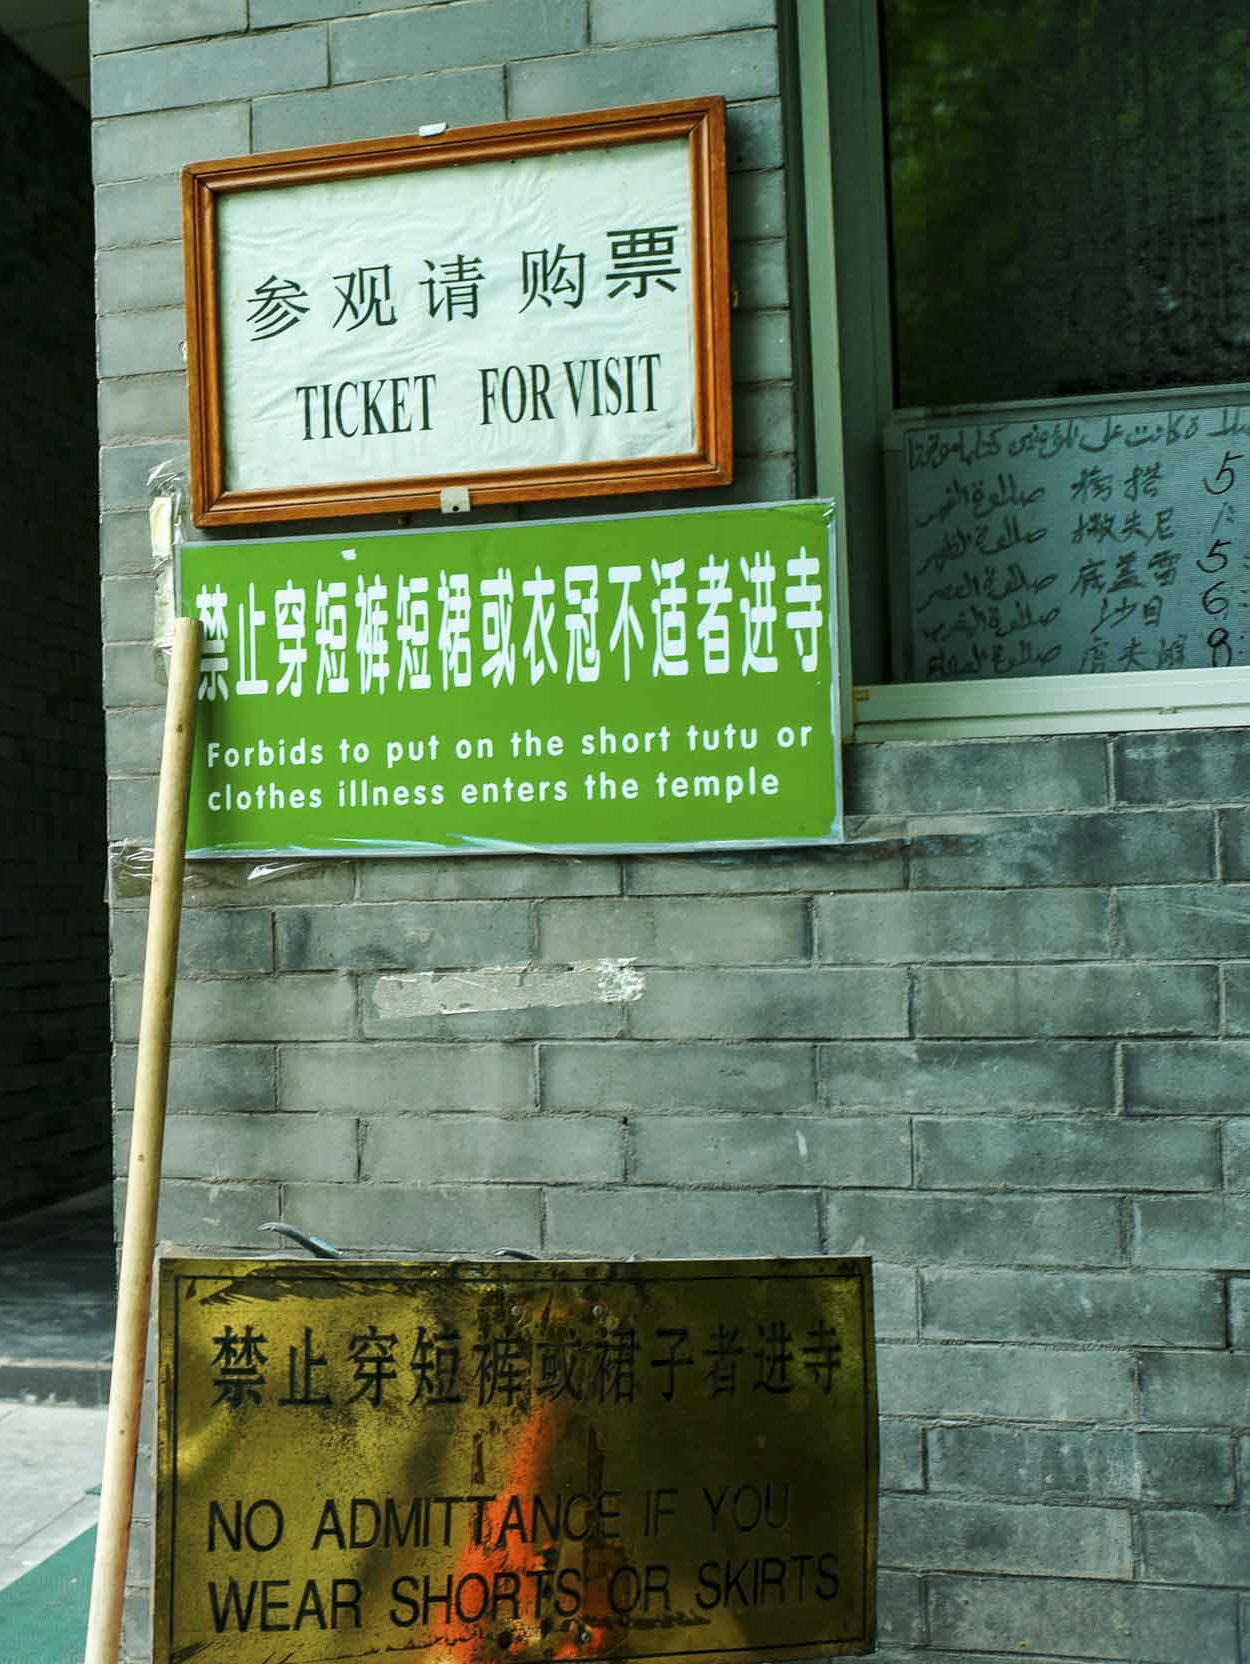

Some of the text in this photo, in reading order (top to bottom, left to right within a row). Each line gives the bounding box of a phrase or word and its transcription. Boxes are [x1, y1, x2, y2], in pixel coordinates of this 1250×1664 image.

[246, 225, 681, 342] 参观请购票
[296, 353, 661, 441] TICKET FOR VISIT
[1203, 450, 1244, 495] 5
[195, 545, 823, 701] 禁止穿短裤短裙或衣冠不适者进寺
[207, 723, 812, 769] Forbids to put on the short tutu or
[207, 766, 779, 812] clothes illness enters the temple
[211, 1319, 842, 1408] 禁止穿短裤或裙子者进寺
[207, 1479, 790, 1551] NO ADMITTANCE IF YOU
[208, 1551, 841, 1633] WEAR SHORTS OR SKIRTS
